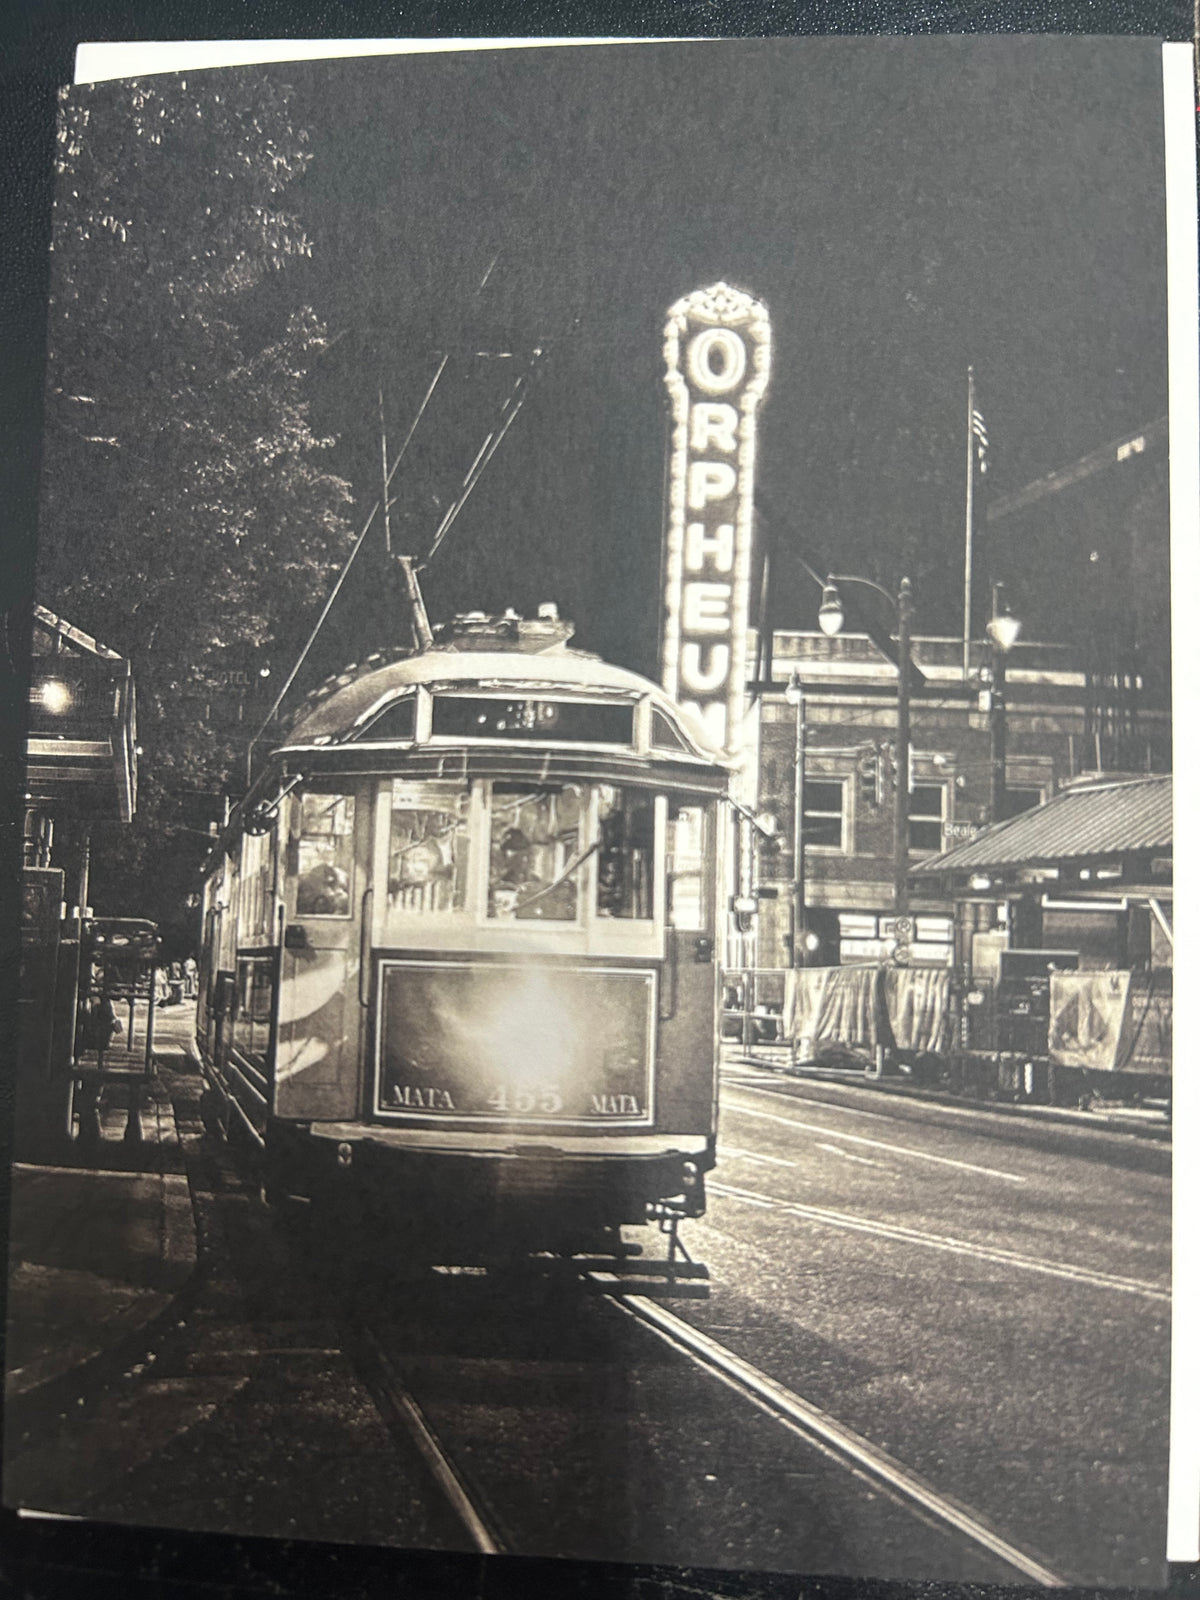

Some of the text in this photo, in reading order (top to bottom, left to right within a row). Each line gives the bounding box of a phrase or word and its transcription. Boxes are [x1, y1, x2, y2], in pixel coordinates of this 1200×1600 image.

[211, 671, 251, 685] OTEL
[392, 1084, 640, 1115] MATA 455 MATA
